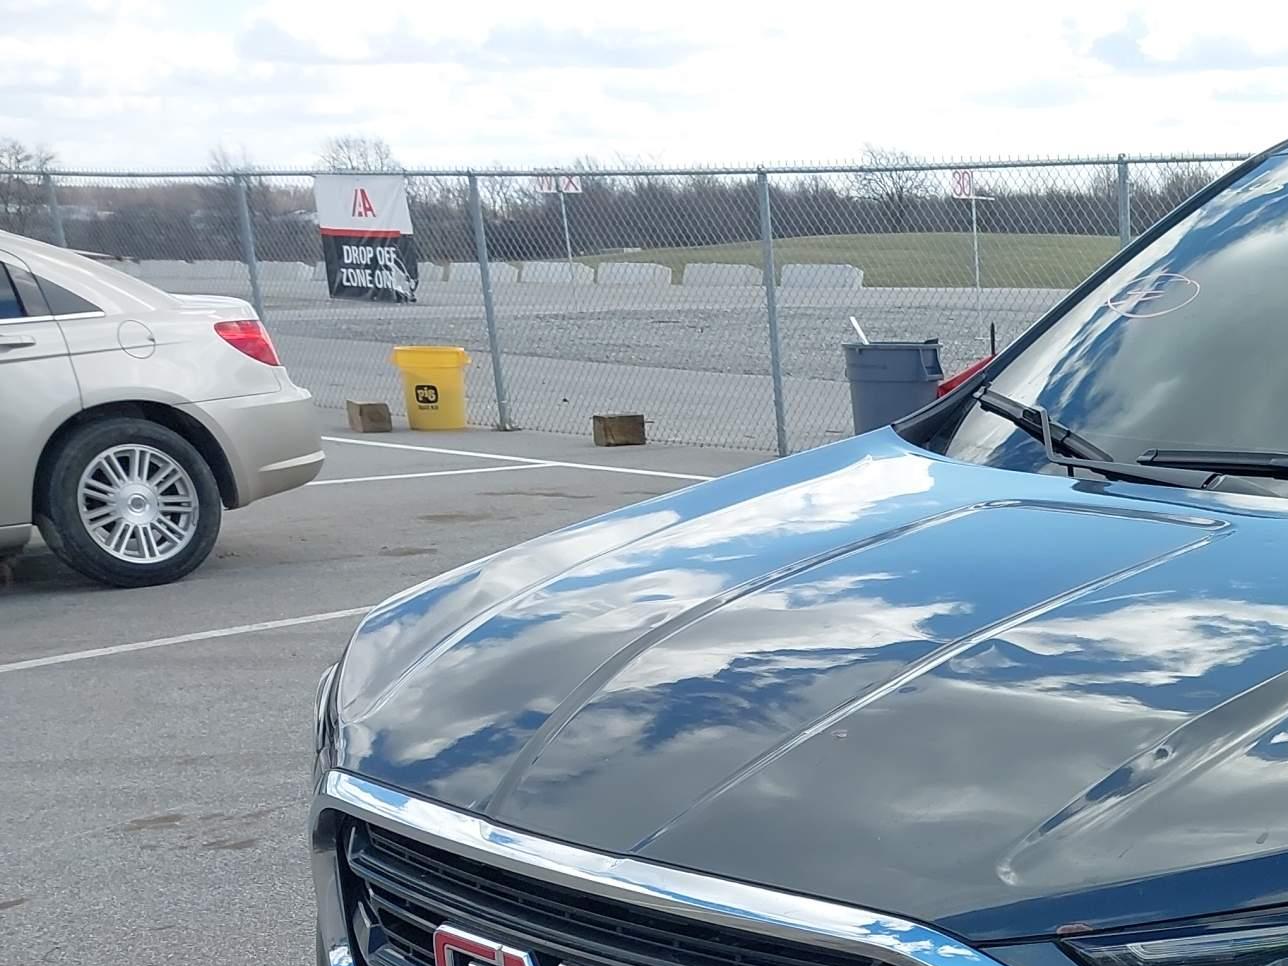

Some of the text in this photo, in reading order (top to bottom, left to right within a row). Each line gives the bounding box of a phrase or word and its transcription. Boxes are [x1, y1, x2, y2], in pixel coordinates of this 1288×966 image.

[953, 170, 971, 197] 30
[342, 245, 374, 265] DROP
[340, 267, 374, 288] ZONE
